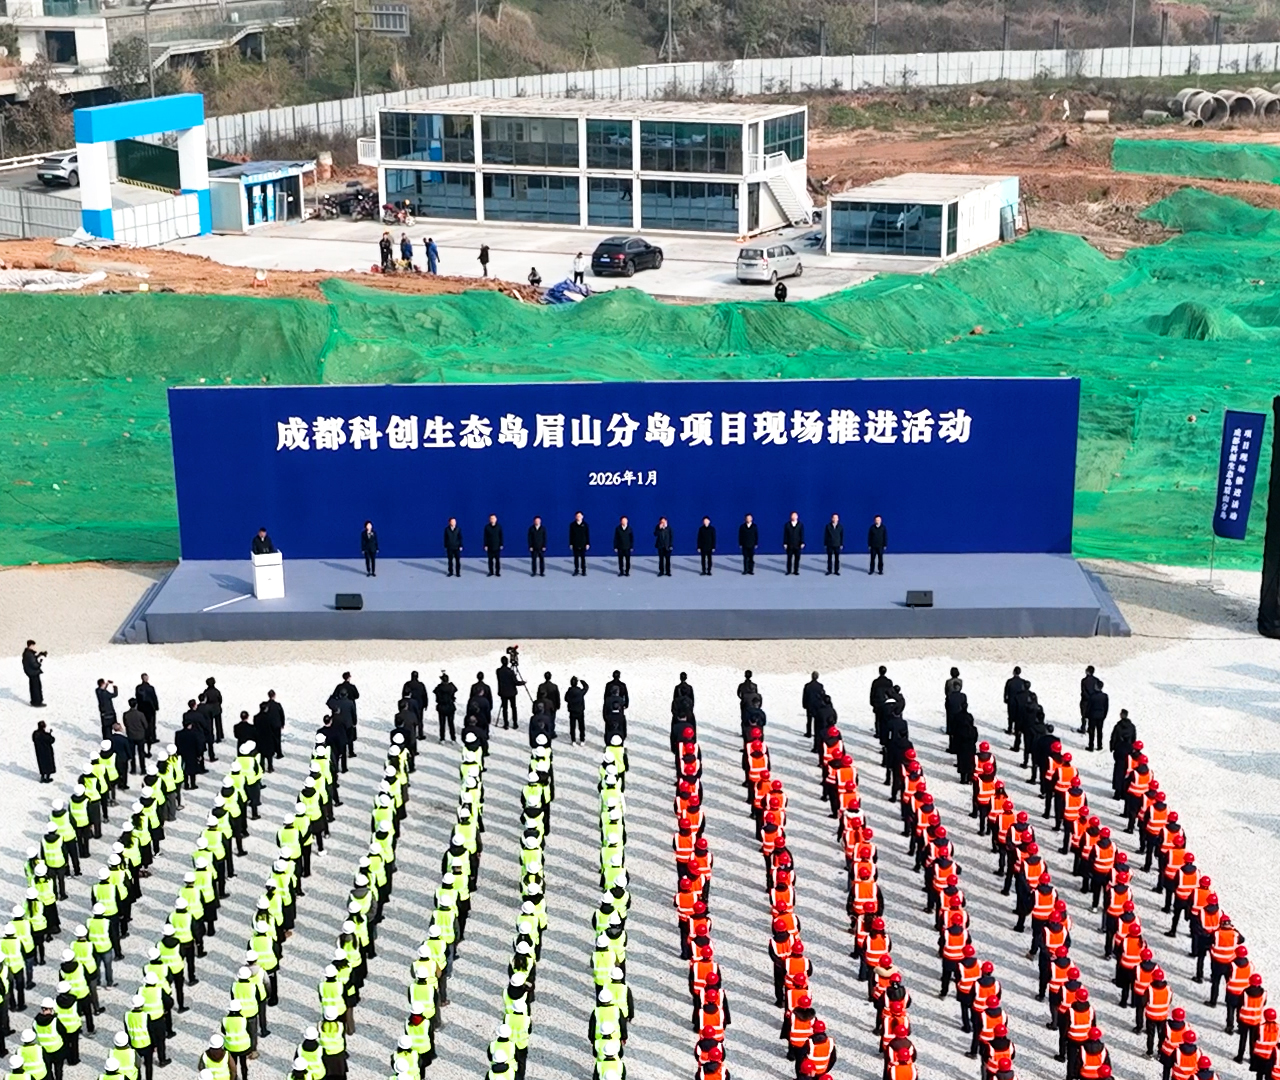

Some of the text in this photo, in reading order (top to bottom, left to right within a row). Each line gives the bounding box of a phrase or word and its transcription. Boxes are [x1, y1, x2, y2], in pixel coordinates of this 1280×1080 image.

[277, 409, 972, 451] 成都科创生态岛眉山分岛项目现场推进活动
[589, 470, 658, 486] 2026年1月
